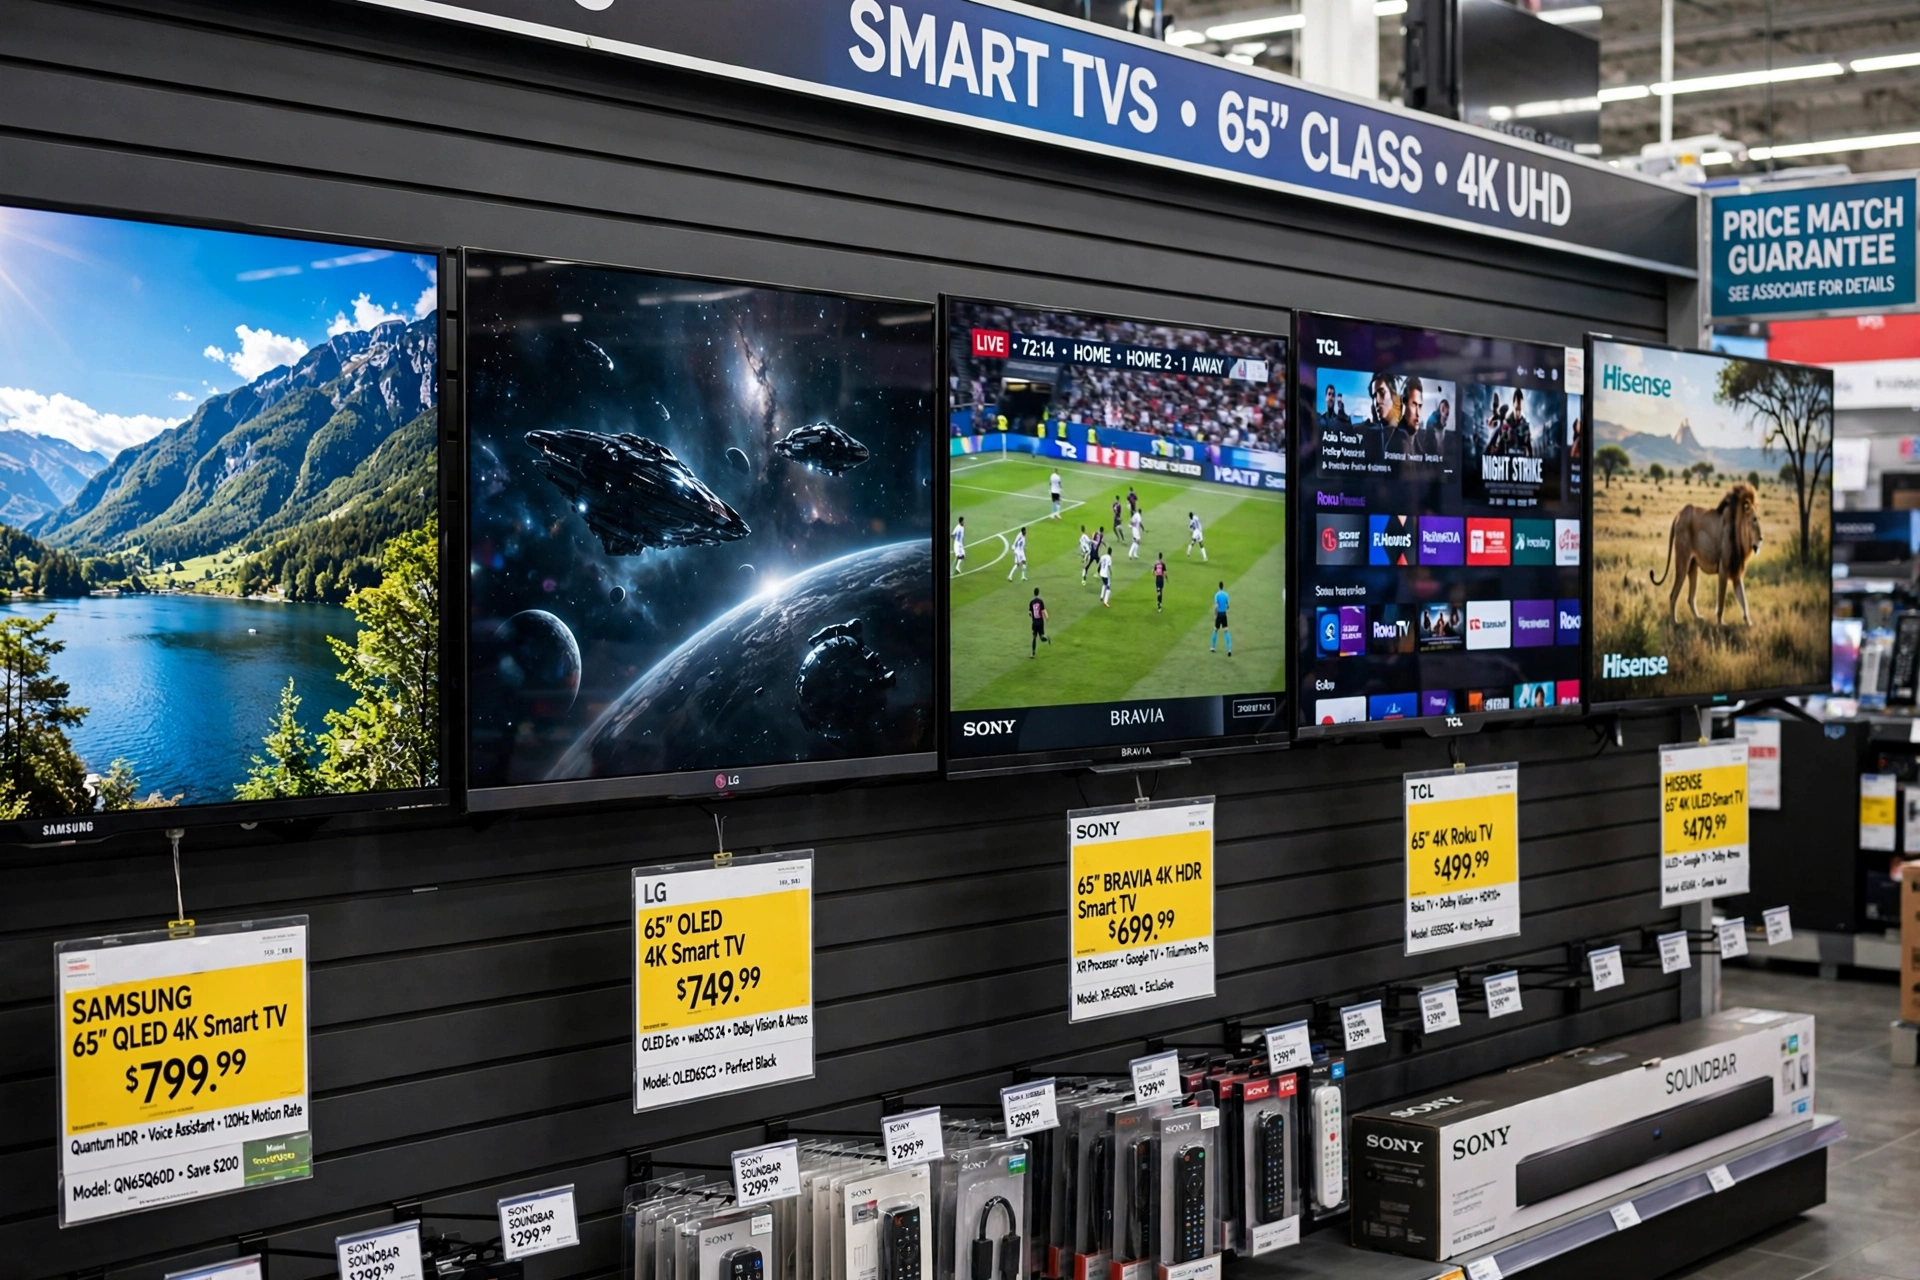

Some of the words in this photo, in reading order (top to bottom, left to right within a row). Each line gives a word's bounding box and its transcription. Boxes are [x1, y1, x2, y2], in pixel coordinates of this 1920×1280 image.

[849, 0, 1049, 108] SMART
[1063, 48, 1158, 134] TVS
[1300, 111, 1423, 194] CLASS
[1457, 152, 1500, 212] 4K
[1507, 162, 1571, 227] UHD
[1723, 205, 1800, 241] PRICE
[1807, 196, 1904, 234] MATCH
[1728, 233, 1896, 275] GUARANTEE
[1728, 285, 1749, 302] SEE
[1752, 281, 1816, 301] ASSOCIATE
[1819, 279, 1843, 296] FOR
[1846, 275, 1895, 295] DETAILS
[976, 334, 1004, 353] LIVE
[1021, 338, 1054, 358] 72:14
[1074, 344, 1111, 364] HOME
[1126, 350, 1161, 369] HOME
[1164, 353, 1171, 370] 2
[1181, 356, 1187, 371] 1
[1192, 356, 1224, 374] AWAY
[1316, 338, 1341, 356] TCL
[1603, 364, 1671, 398] Hisense
[1482, 454, 1510, 481] NIGHT
[1512, 457, 1543, 483] STRIKE
[1602, 653, 1669, 679] Hisense
[963, 719, 1016, 737] SONY
[1110, 707, 1165, 726] BRAVIA
[1445, 717, 1463, 727] TCL
[1121, 747, 1151, 757] BRAVIA
[728, 775, 739, 785] LG
[1411, 784, 1434, 800] TCL
[1665, 773, 1702, 793] HISENSE
[1679, 796, 1688, 811] 4K
[1691, 792, 1712, 810] ULED
[1712, 792, 1733, 807] Smart
[1734, 789, 1744, 803] TV
[42, 821, 94, 836] SAMSUNG
[1076, 821, 1120, 839] SONY
[1411, 830, 1430, 850] 65"
[1433, 828, 1448, 847] 4K
[1451, 825, 1477, 846] Roku
[1479, 823, 1493, 841] TV
[1683, 814, 1727, 841] $479.99
[1077, 874, 1100, 896] 65"
[1104, 868, 1153, 892] BRAVIA
[1156, 865, 1173, 885] 4K
[1176, 861, 1202, 882] HDR
[1434, 850, 1489, 882] $499.99
[644, 882, 667, 904] LG
[1078, 898, 1117, 919] Smart
[1119, 893, 1136, 914] TV
[1426, 899, 1434, 910] TV
[644, 915, 673, 940] 65"
[678, 909, 723, 936] OLED
[1108, 909, 1175, 945] $699.99
[644, 944, 667, 967] 4K
[672, 938, 720, 964] Smart
[723, 933, 746, 957] TV
[1087, 957, 1119, 973] Processor
[1126, 951, 1149, 966] Google
[1150, 948, 1160, 961] TV
[1198, 942, 1209, 954] Pro
[677, 966, 761, 1010] $749.99
[72, 985, 192, 1024] SAMSUNG
[73, 1029, 107, 1057] 65"
[113, 1021, 167, 1051] QLED
[173, 1016, 198, 1041] 4K
[203, 1009, 259, 1037] Smart
[263, 1004, 288, 1028] TV
[642, 1035, 664, 1052] OLED
[666, 1034, 680, 1049] Evo
[715, 1025, 725, 1040] 24
[733, 1020, 754, 1037] Dolby
[755, 1017, 777, 1033] Vision
[779, 1015, 784, 1027] &
[125, 1048, 246, 1104] $799.99
[643, 1075, 671, 1091] Model:
[725, 1058, 753, 1076] Perfect
[756, 1053, 777, 1070] Black
[1666, 1053, 1737, 1095] SOUNDBAR
[1010, 1109, 1040, 1127] $299.99
[1390, 1096, 1464, 1118] SONY
[71, 1138, 115, 1156] Quantum
[116, 1130, 138, 1149] HDR
[149, 1124, 173, 1142] Voice
[175, 1117, 215, 1138] Assistant
[224, 1110, 250, 1129] 120Hz
[252, 1106, 281, 1124] Motion
[283, 1103, 303, 1119] Rate
[1165, 1122, 1192, 1133] SONY
[892, 1140, 924, 1159] $299.99
[1366, 1134, 1424, 1154] SONY
[1453, 1125, 1511, 1161] SONY
[740, 1155, 763, 1167] SONY
[961, 1160, 988, 1172] SONY
[73, 1182, 112, 1201] Model:
[114, 1168, 175, 1195] QN65Q60D
[187, 1163, 211, 1180] Save
[213, 1156, 239, 1174] $200
[742, 1177, 779, 1196] $299.99
[850, 1187, 873, 1199] SONY
[508, 1204, 534, 1216] SONY
[347, 1240, 376, 1254] SONY
[511, 1225, 551, 1247] $299.99
[704, 1232, 734, 1247] SONY
[348, 1246, 400, 1268] SOUNDBAR
